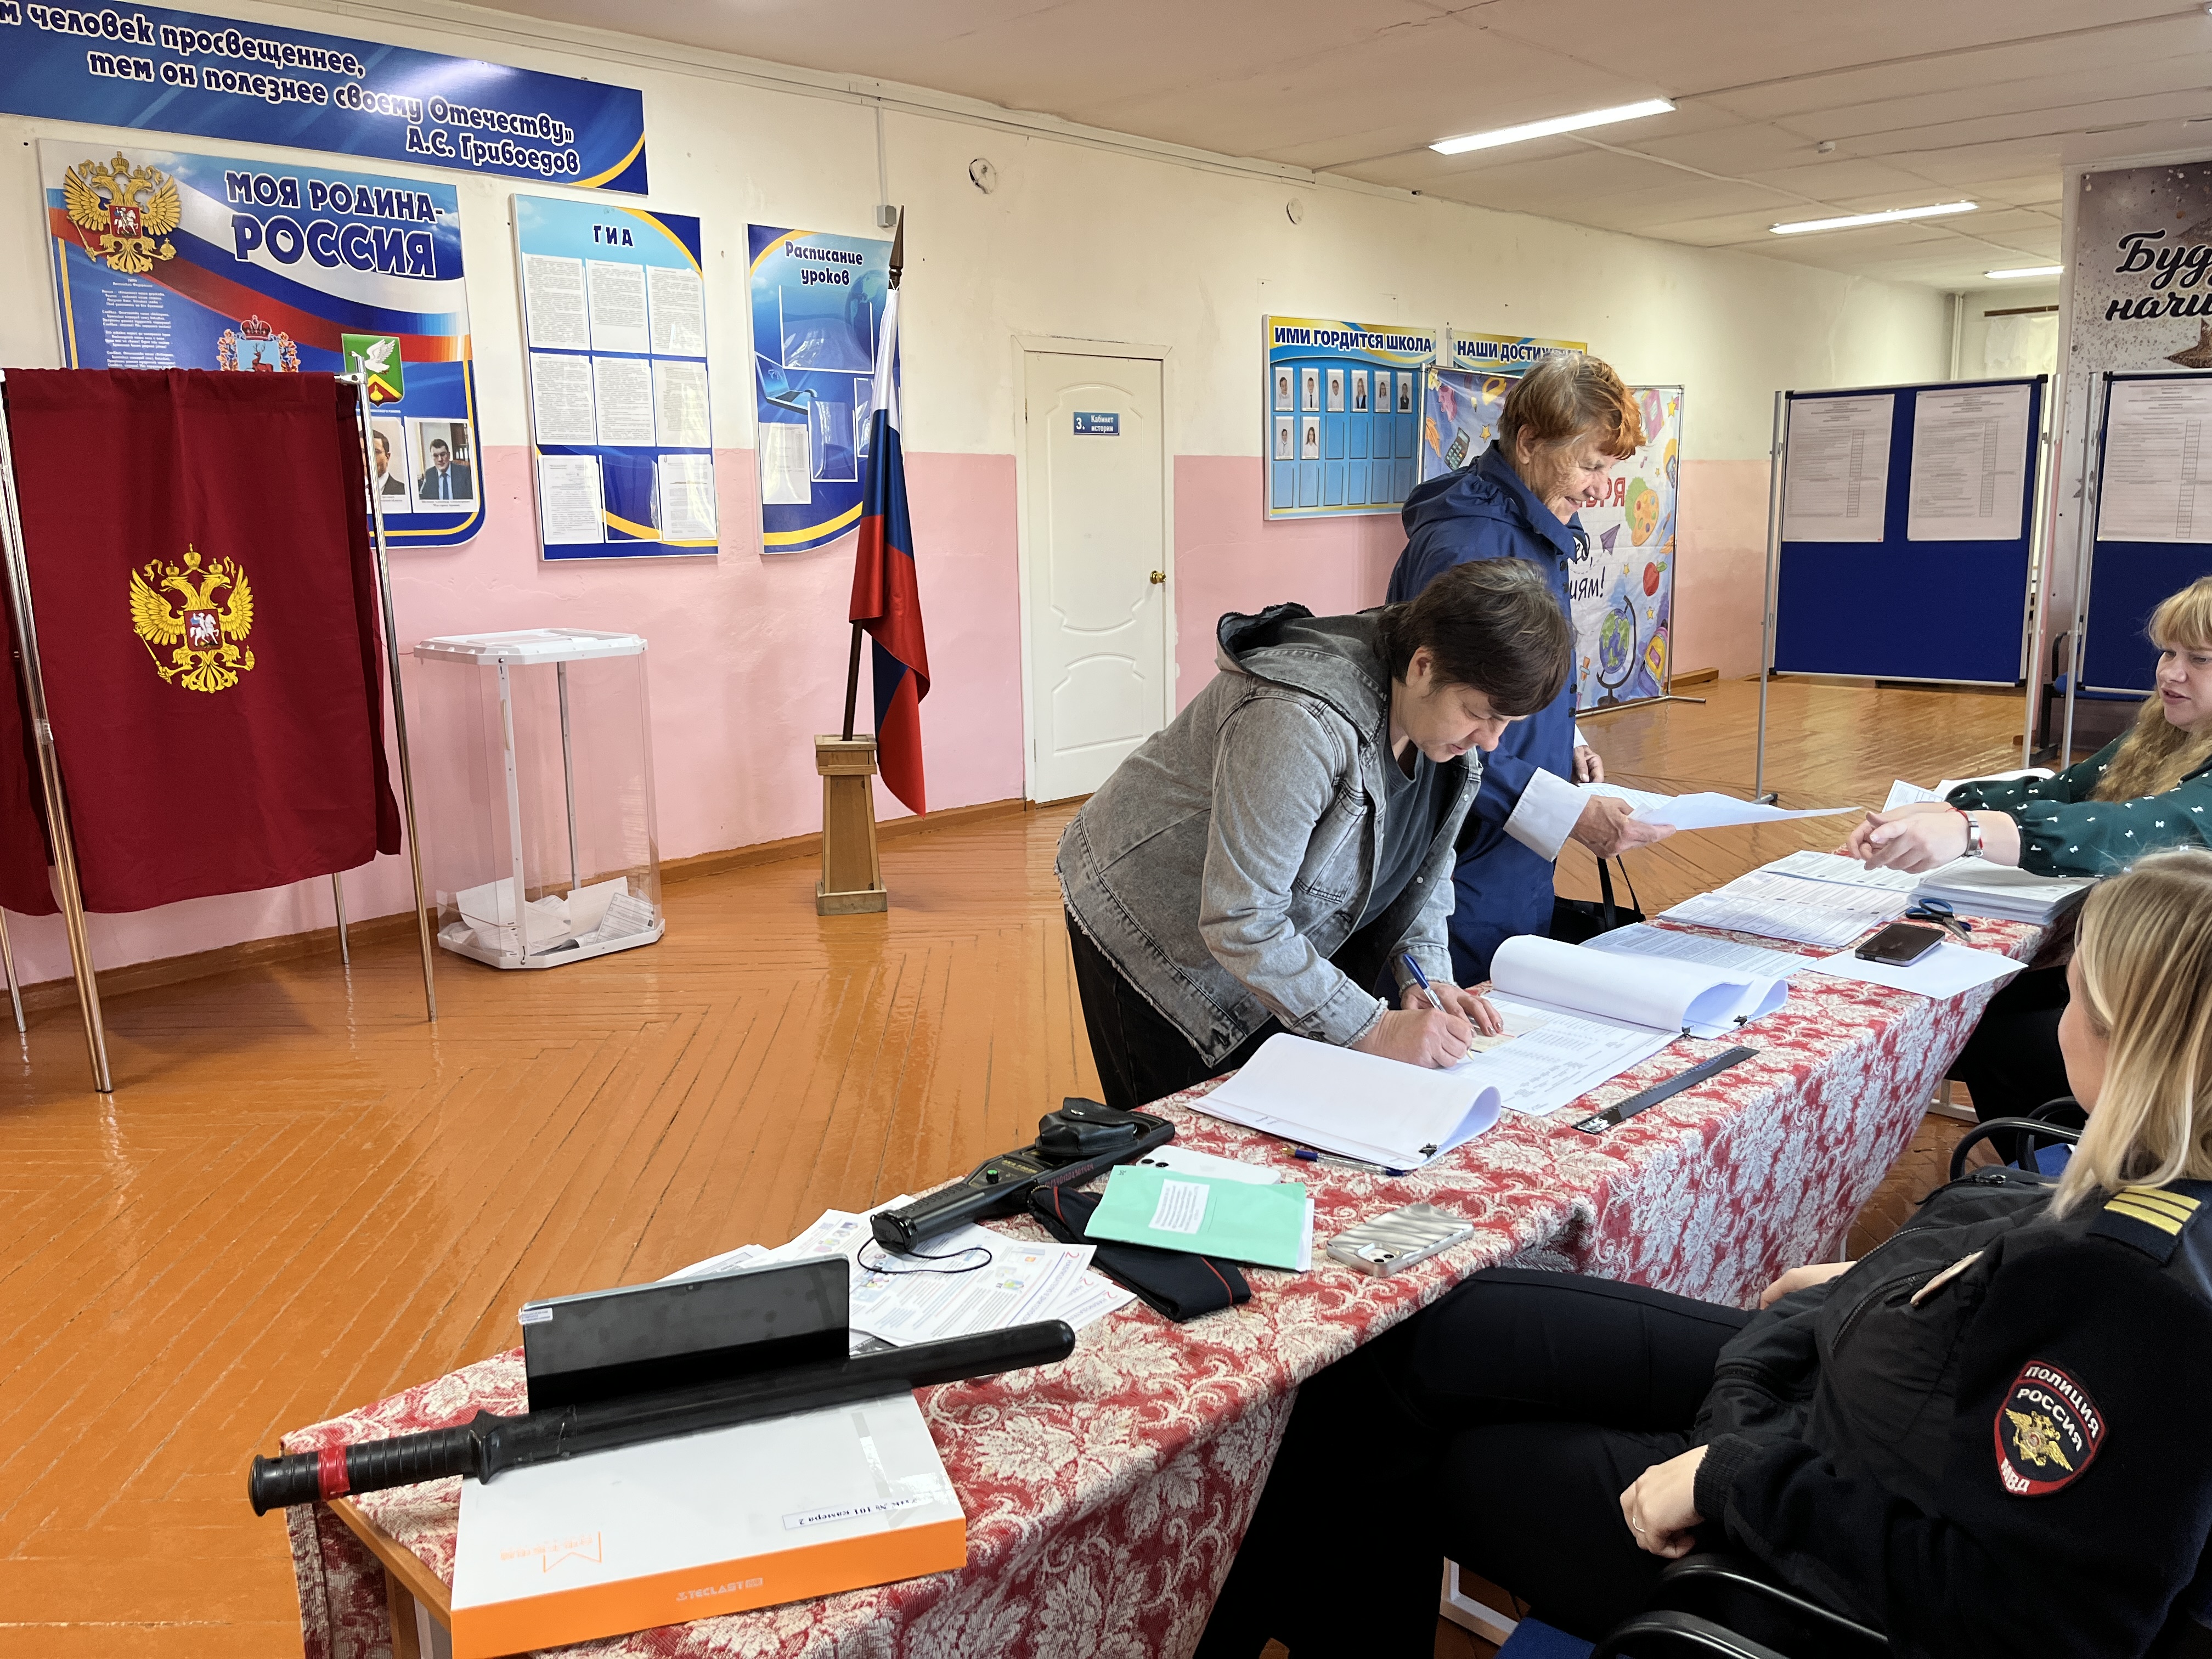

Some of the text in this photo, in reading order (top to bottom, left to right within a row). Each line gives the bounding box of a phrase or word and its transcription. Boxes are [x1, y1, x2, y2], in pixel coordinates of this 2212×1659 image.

[0, 1, 365, 78] м человек просвещеннее,
[88, 51, 154, 82] тем
[161, 62, 198, 88] он
[204, 67, 328, 105] полезнее
[334, 82, 423, 123] своему
[407, 127, 580, 176] А.С. Грибоедов
[225, 170, 444, 224] МОЯ РОДИНА-
[231, 212, 436, 277] РОССИЯ
[592, 223, 635, 248] ГИА
[784, 240, 864, 266] Расписание
[2115, 229, 2212, 290] Буд
[800, 267, 850, 286] уроков
[1274, 326, 1432, 352] ИМИ ГОРДИТСЯ ШКОЛА
[1457, 340, 1498, 358] НАШИ
[1076, 417, 1085, 430] 3.
[1091, 415, 1114, 424] Кабинет
[2024, 1366, 2100, 1438] ПОЛИЦИЯ
[2016, 1388, 2083, 1452] РОССИЯ
[2001, 1457, 2030, 1493] МВД
[808, 1510, 850, 1522] камера
[854, 1506, 871, 1515] 101
[689, 1581, 744, 1599] TECLAST
